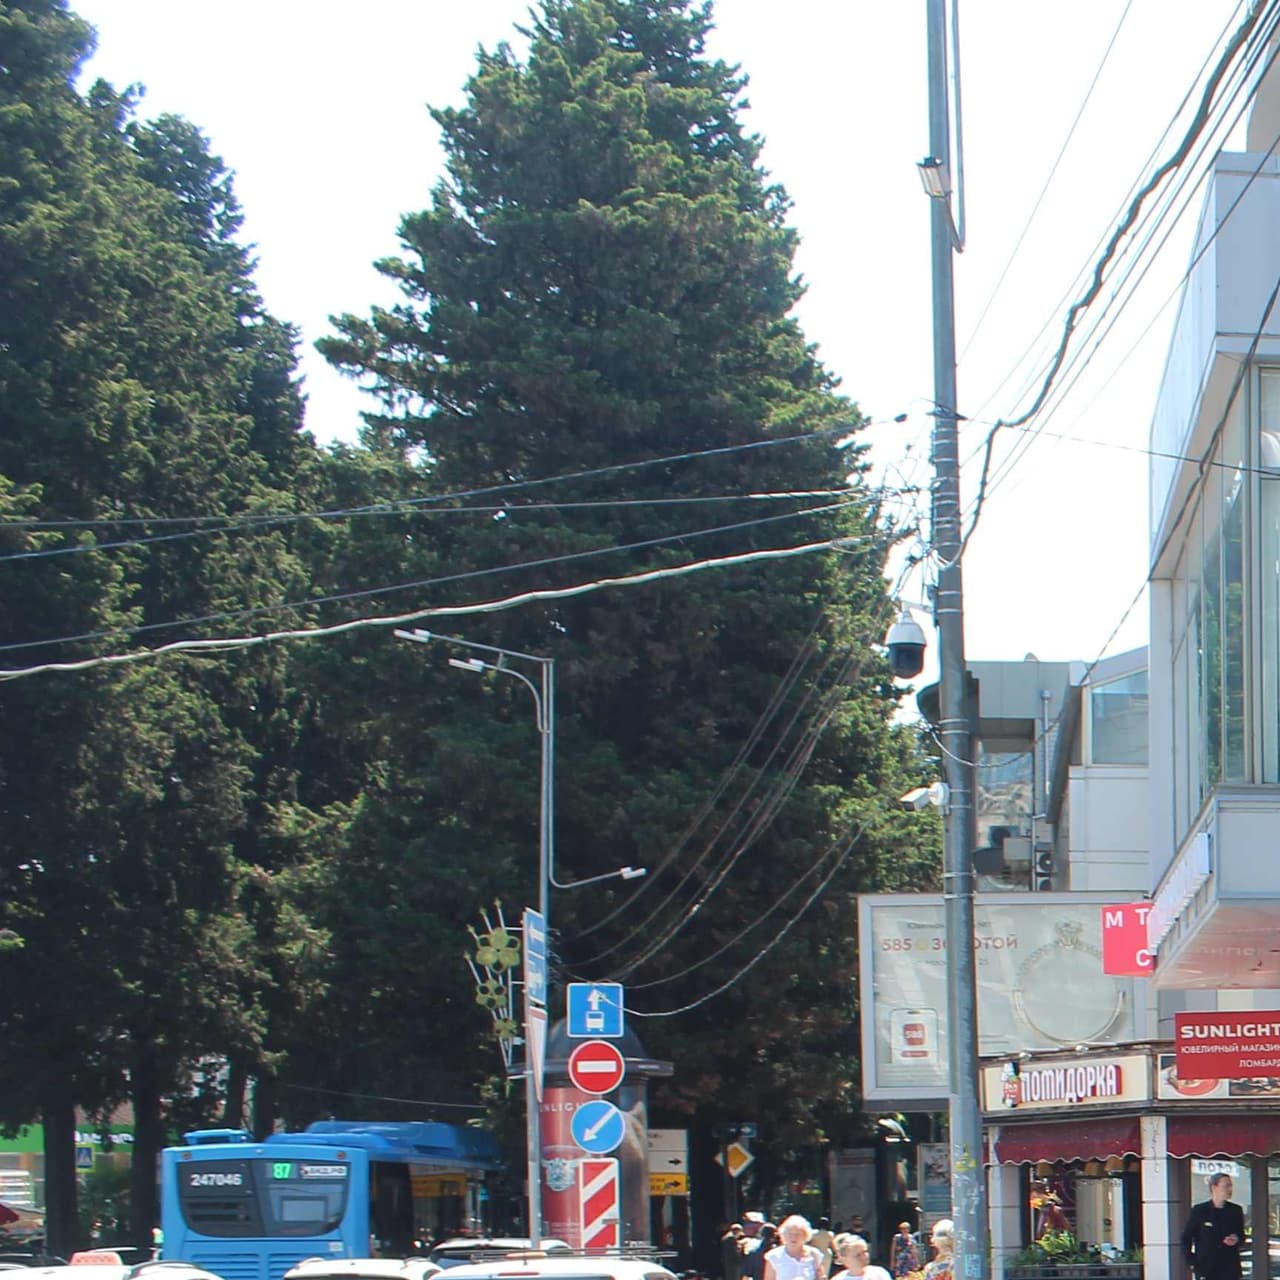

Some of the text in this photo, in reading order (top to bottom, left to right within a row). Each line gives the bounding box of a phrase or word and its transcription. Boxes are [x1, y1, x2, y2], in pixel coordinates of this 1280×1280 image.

[882, 933, 1019, 951] 585 ЗОТОЙ
[1181, 1042, 1239, 1054] ЮВЕЛИРНЫЙ
[1020, 1064, 1118, 1102] ПОМИДОРКА
[272, 1162, 293, 1179] 87
[190, 1173, 242, 1187] 247046
